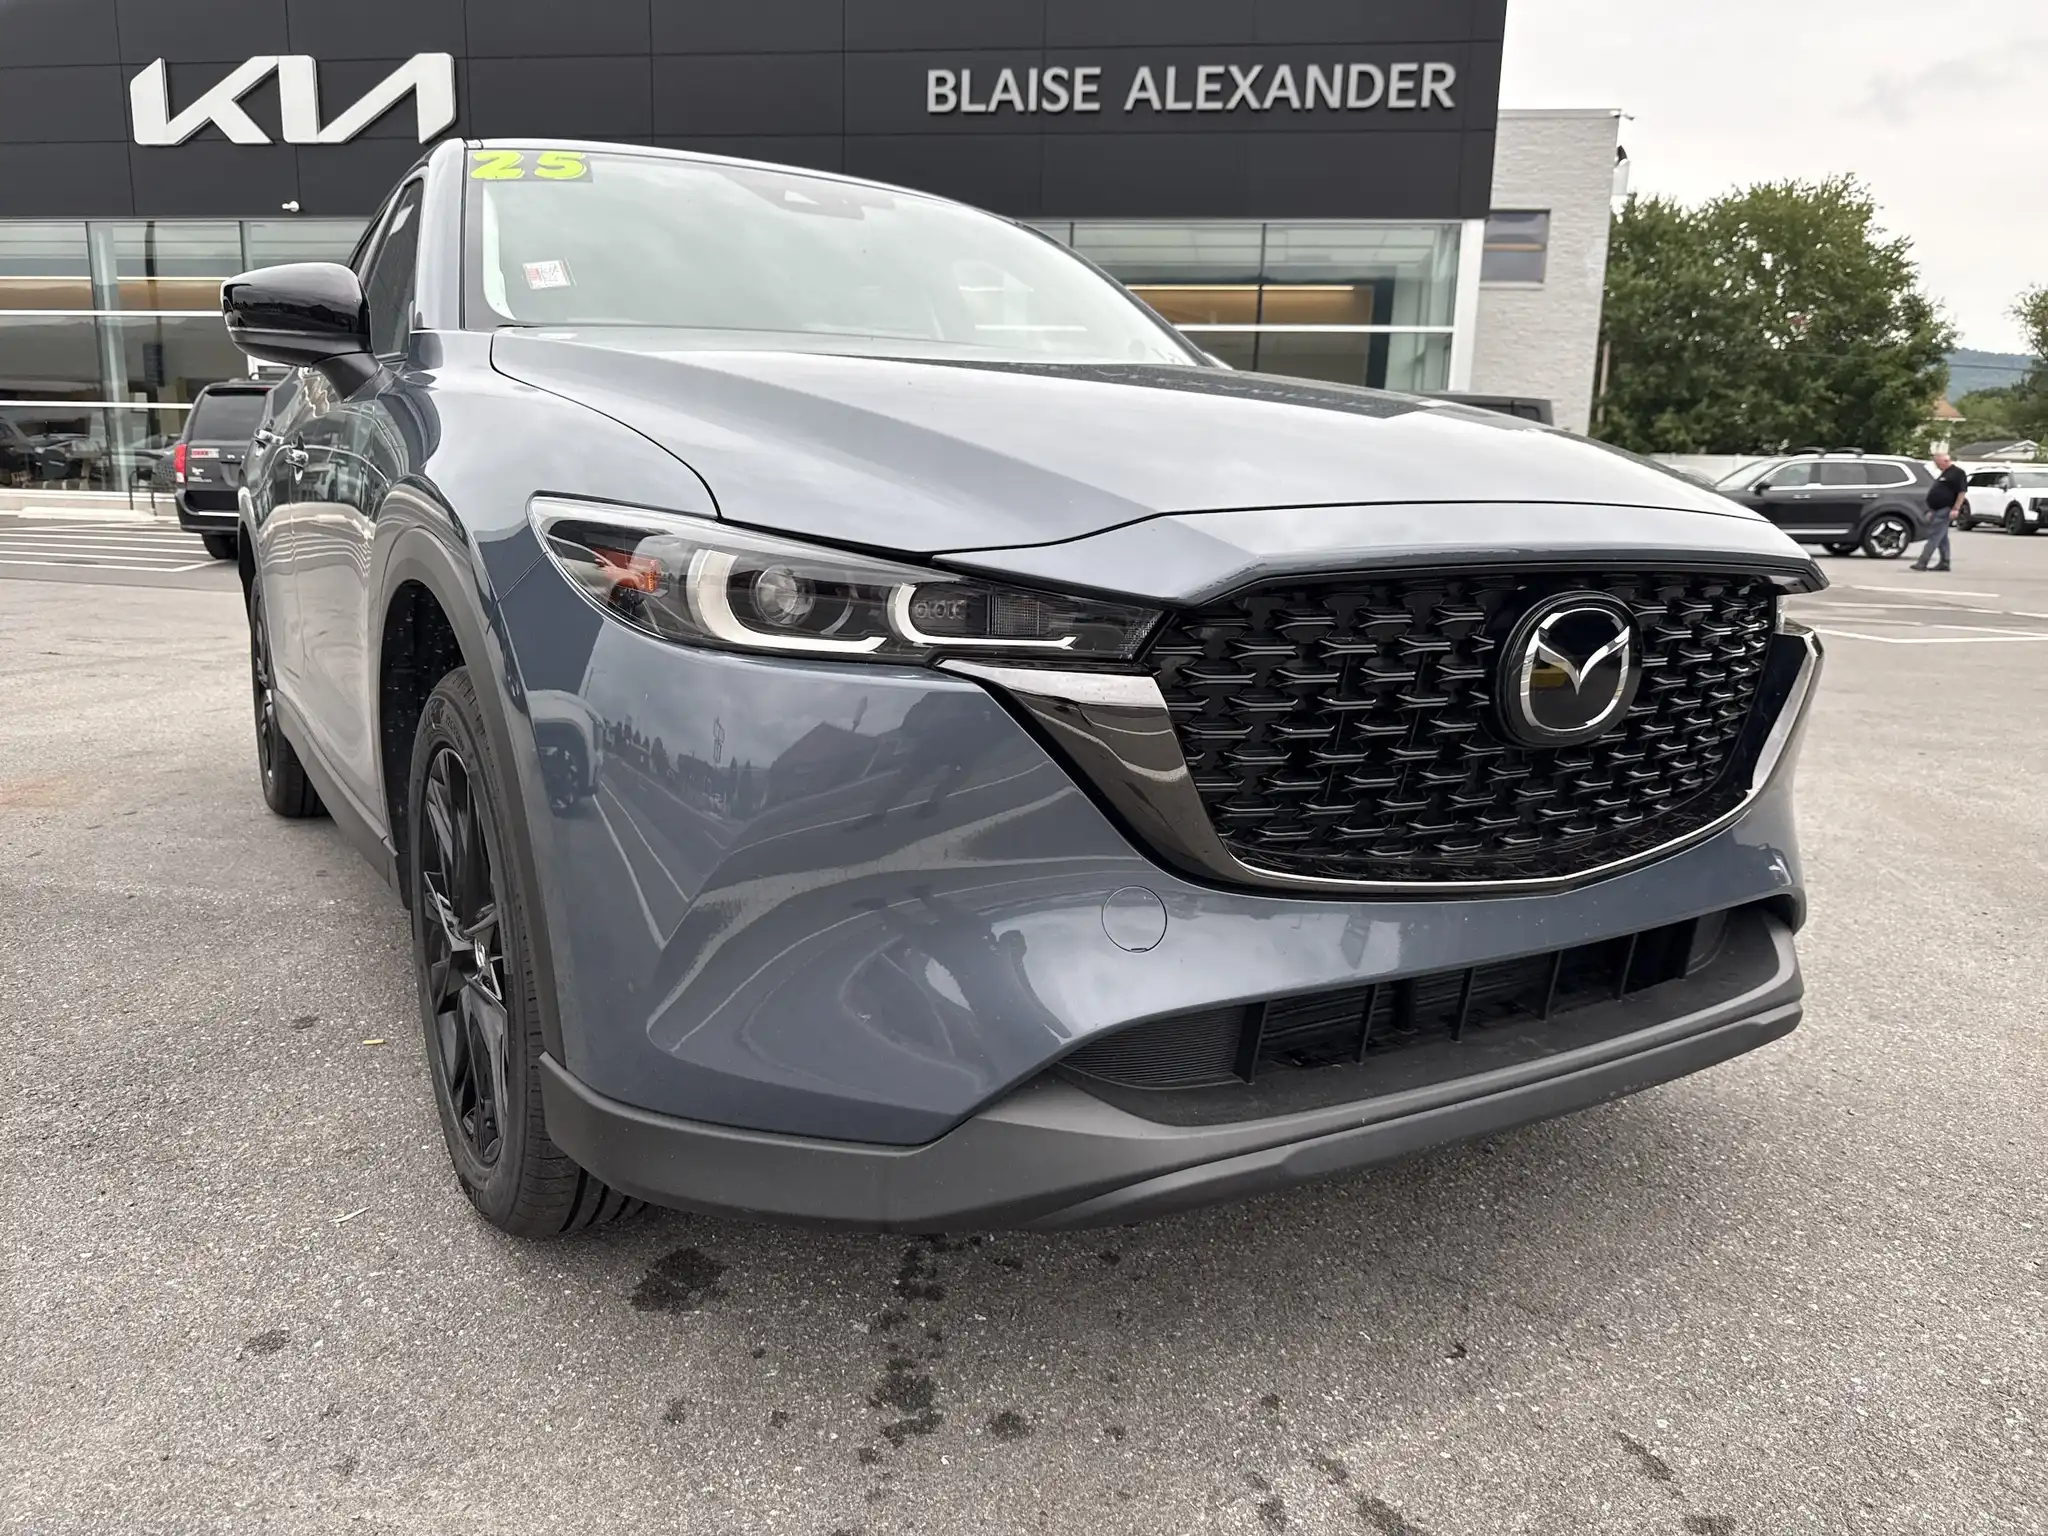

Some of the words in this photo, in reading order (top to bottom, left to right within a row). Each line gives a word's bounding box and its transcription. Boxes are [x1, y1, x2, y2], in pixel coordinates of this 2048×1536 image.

[130, 53, 455, 146] KIA
[926, 66, 1101, 113] BLAISE
[1123, 62, 1457, 111] ALEXANDER
[470, 150, 587, 180] 25
